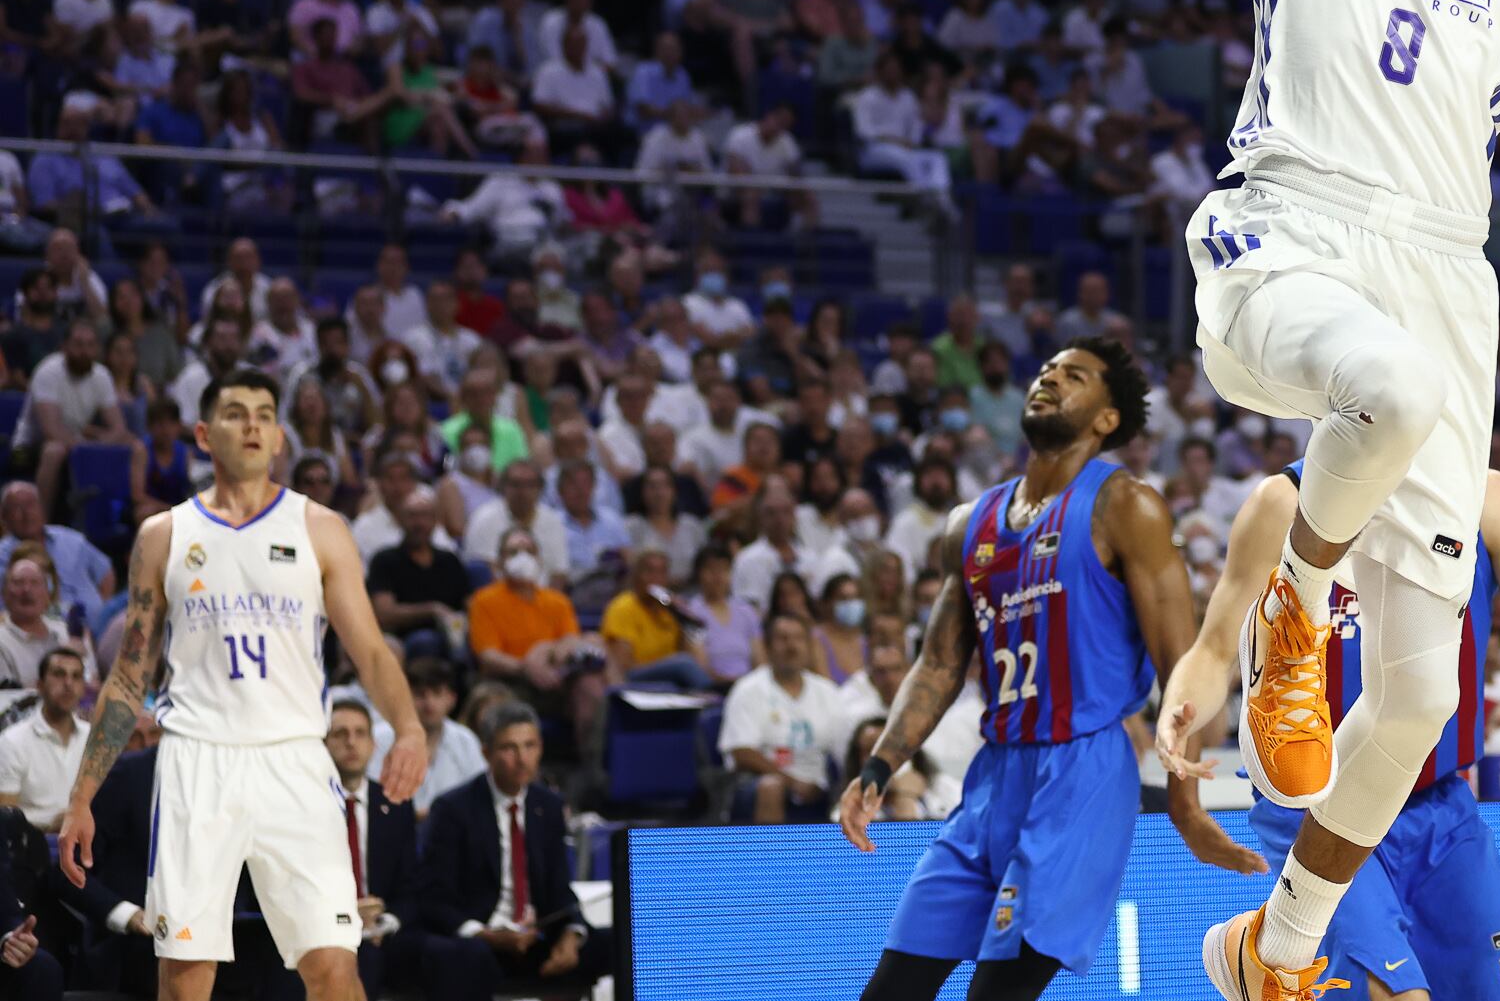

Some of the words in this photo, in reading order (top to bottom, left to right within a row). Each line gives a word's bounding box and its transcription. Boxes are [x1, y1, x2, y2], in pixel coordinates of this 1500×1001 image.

[1431, 0, 1494, 29] ROUP
[1378, 7, 1427, 86] 8
[1434, 542, 1456, 556] acb
[224, 634, 267, 680] 14
[993, 641, 1038, 705] 22
